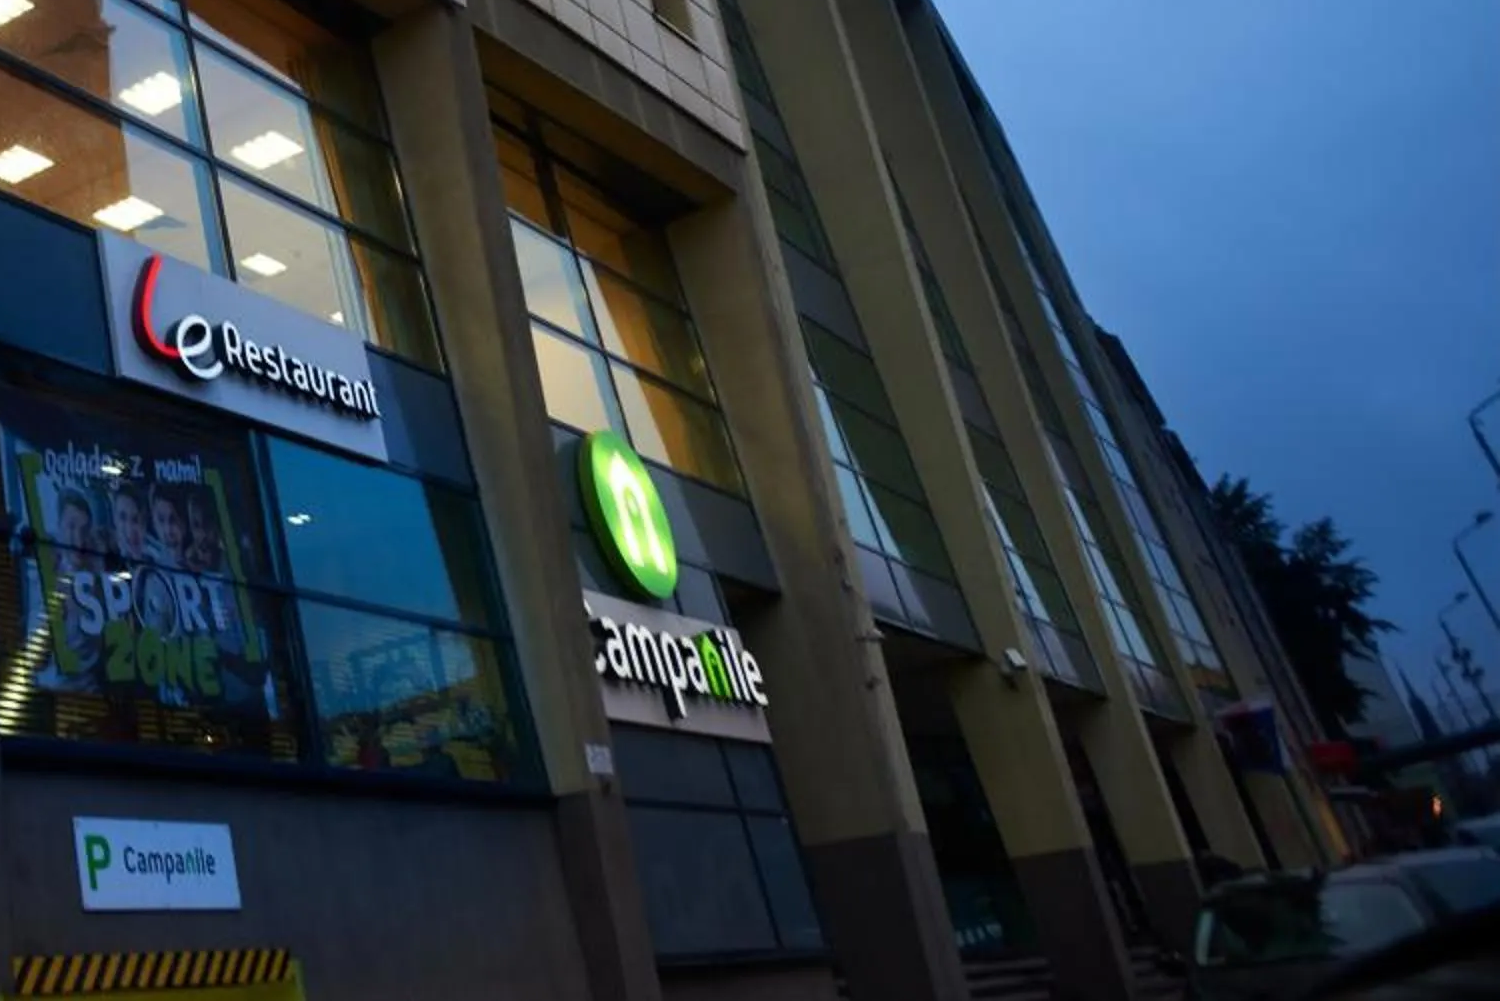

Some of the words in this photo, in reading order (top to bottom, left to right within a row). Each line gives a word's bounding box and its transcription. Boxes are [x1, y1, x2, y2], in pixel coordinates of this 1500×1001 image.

[222, 320, 381, 417] Restaurant
[73, 566, 227, 639] SPORT
[103, 618, 223, 696] ZONE
[84, 833, 112, 892] P
[123, 846, 216, 885] Campanile
